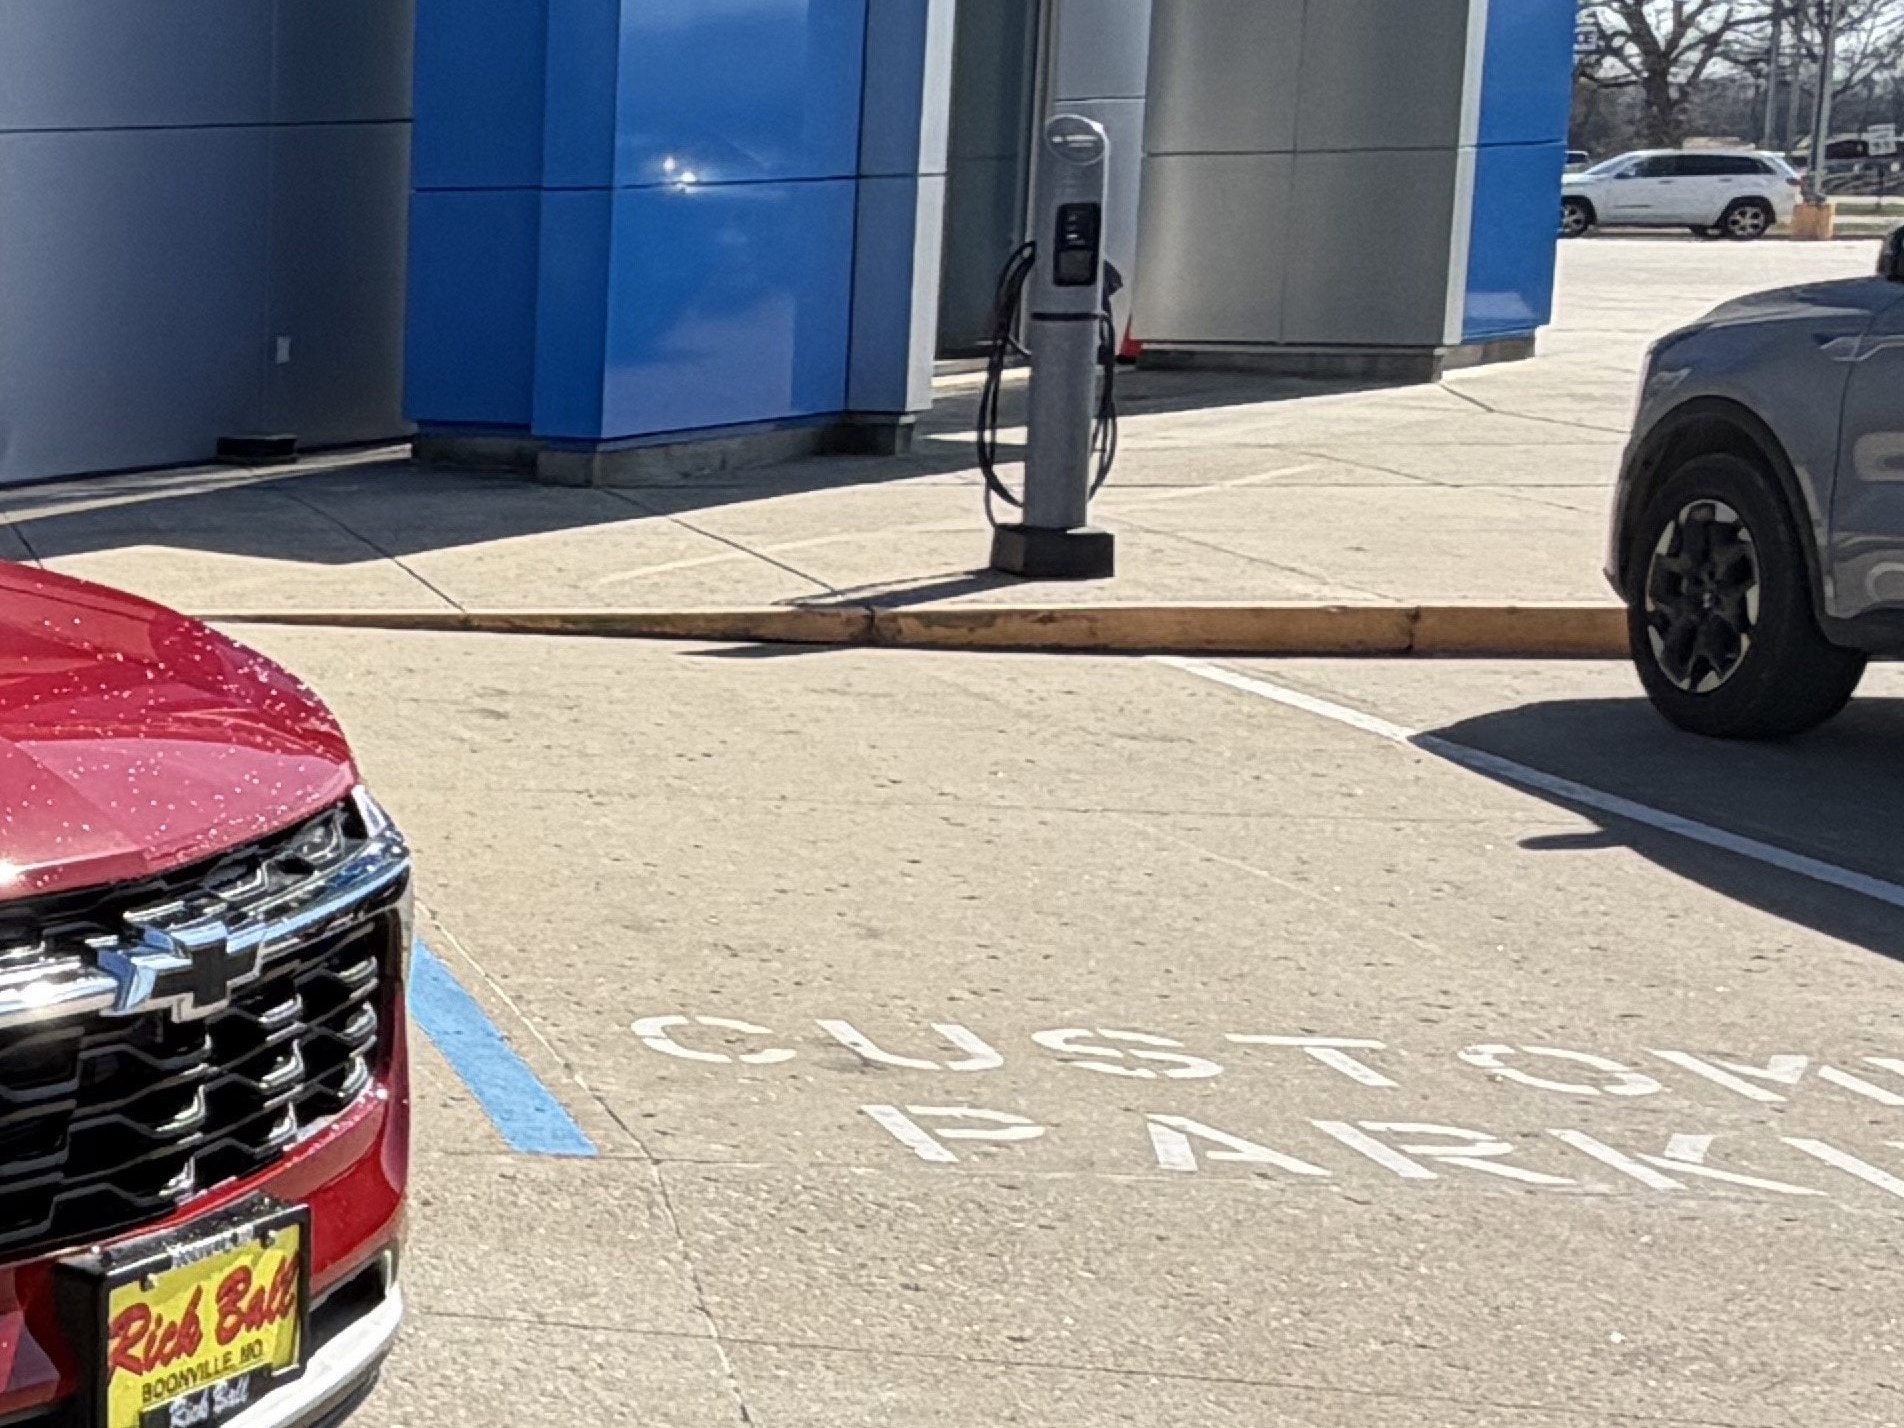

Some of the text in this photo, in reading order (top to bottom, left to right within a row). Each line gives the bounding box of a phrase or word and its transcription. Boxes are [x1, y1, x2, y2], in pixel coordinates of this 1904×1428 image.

[630, 1014, 1904, 1107] CUSTOM
[860, 1103, 1904, 1200] PARKI
[108, 1251, 300, 1384] Rick Ball
